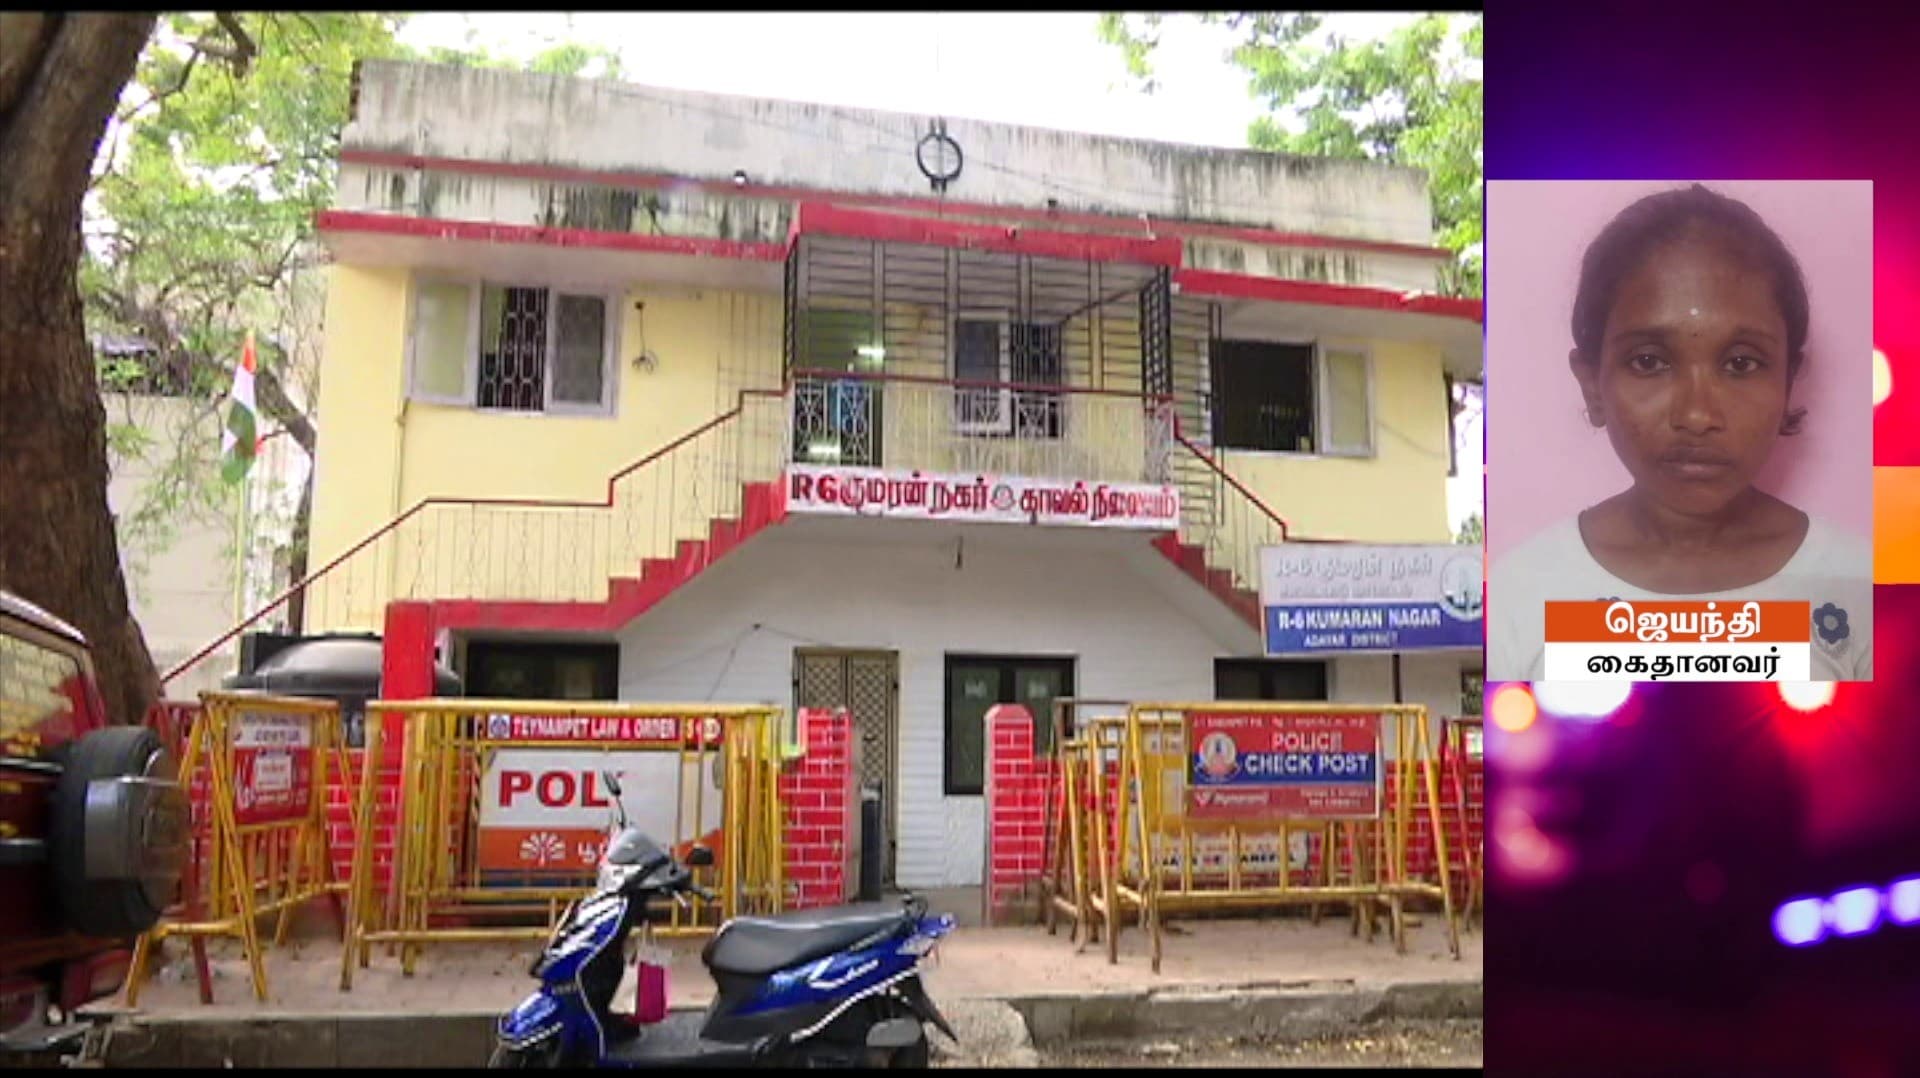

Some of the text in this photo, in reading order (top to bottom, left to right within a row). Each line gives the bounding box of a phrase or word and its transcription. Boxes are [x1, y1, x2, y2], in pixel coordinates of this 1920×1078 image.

[929, 476, 988, 514] நகர்
[1021, 481, 1089, 525] காவல்
[1305, 609, 1383, 629] KUMARAN
[1388, 608, 1441, 628] NAGAR
[513, 717, 589, 739] TEYNAMPET
[590, 717, 619, 738] LAW
[1271, 731, 1344, 751] POLICE
[1244, 754, 1369, 775] CHECK POST
